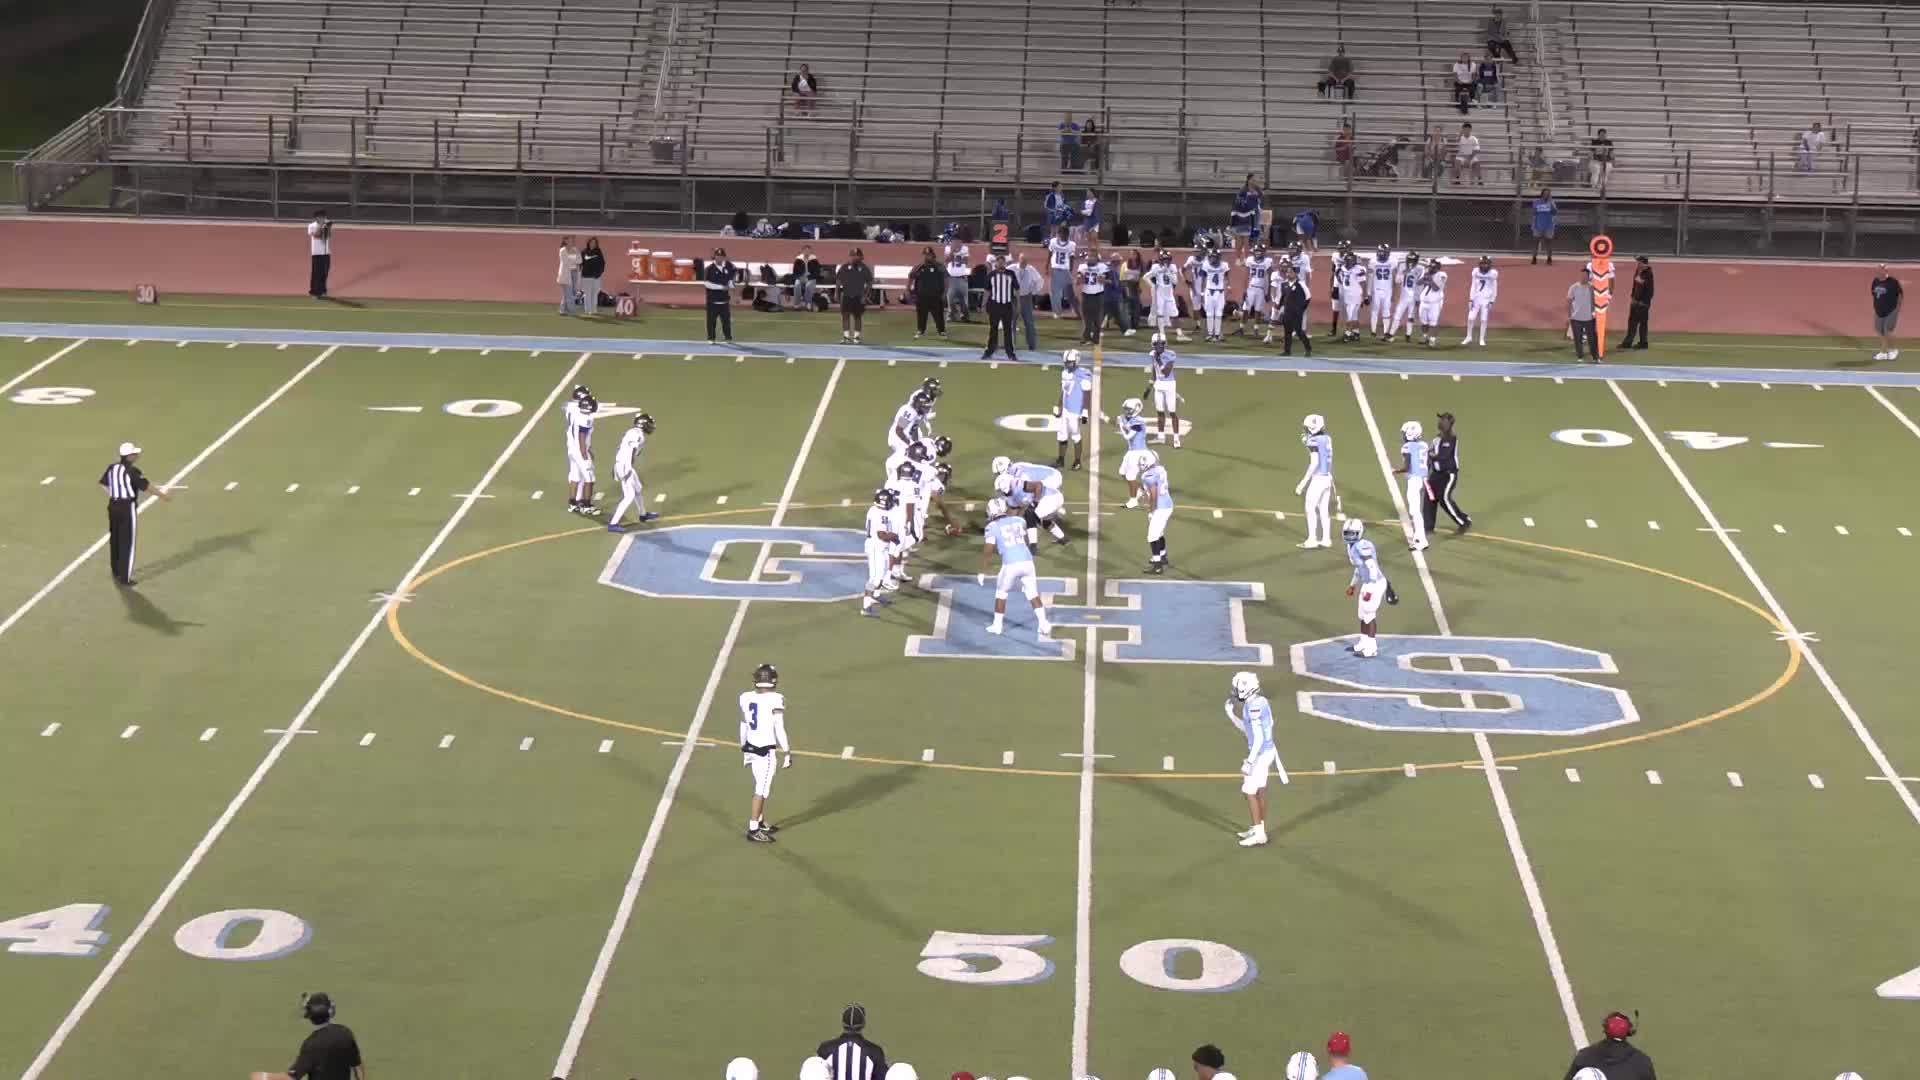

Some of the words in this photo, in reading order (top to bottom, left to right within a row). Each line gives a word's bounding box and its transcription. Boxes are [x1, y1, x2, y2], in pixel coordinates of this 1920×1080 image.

[993, 223, 1008, 243] 2
[1055, 251, 1066, 265] 12
[1211, 273, 1220, 286] 4
[1477, 279, 1487, 292] 7
[137, 286, 154, 303] 30
[616, 299, 634, 315] 40
[748, 701, 758, 731] 3
